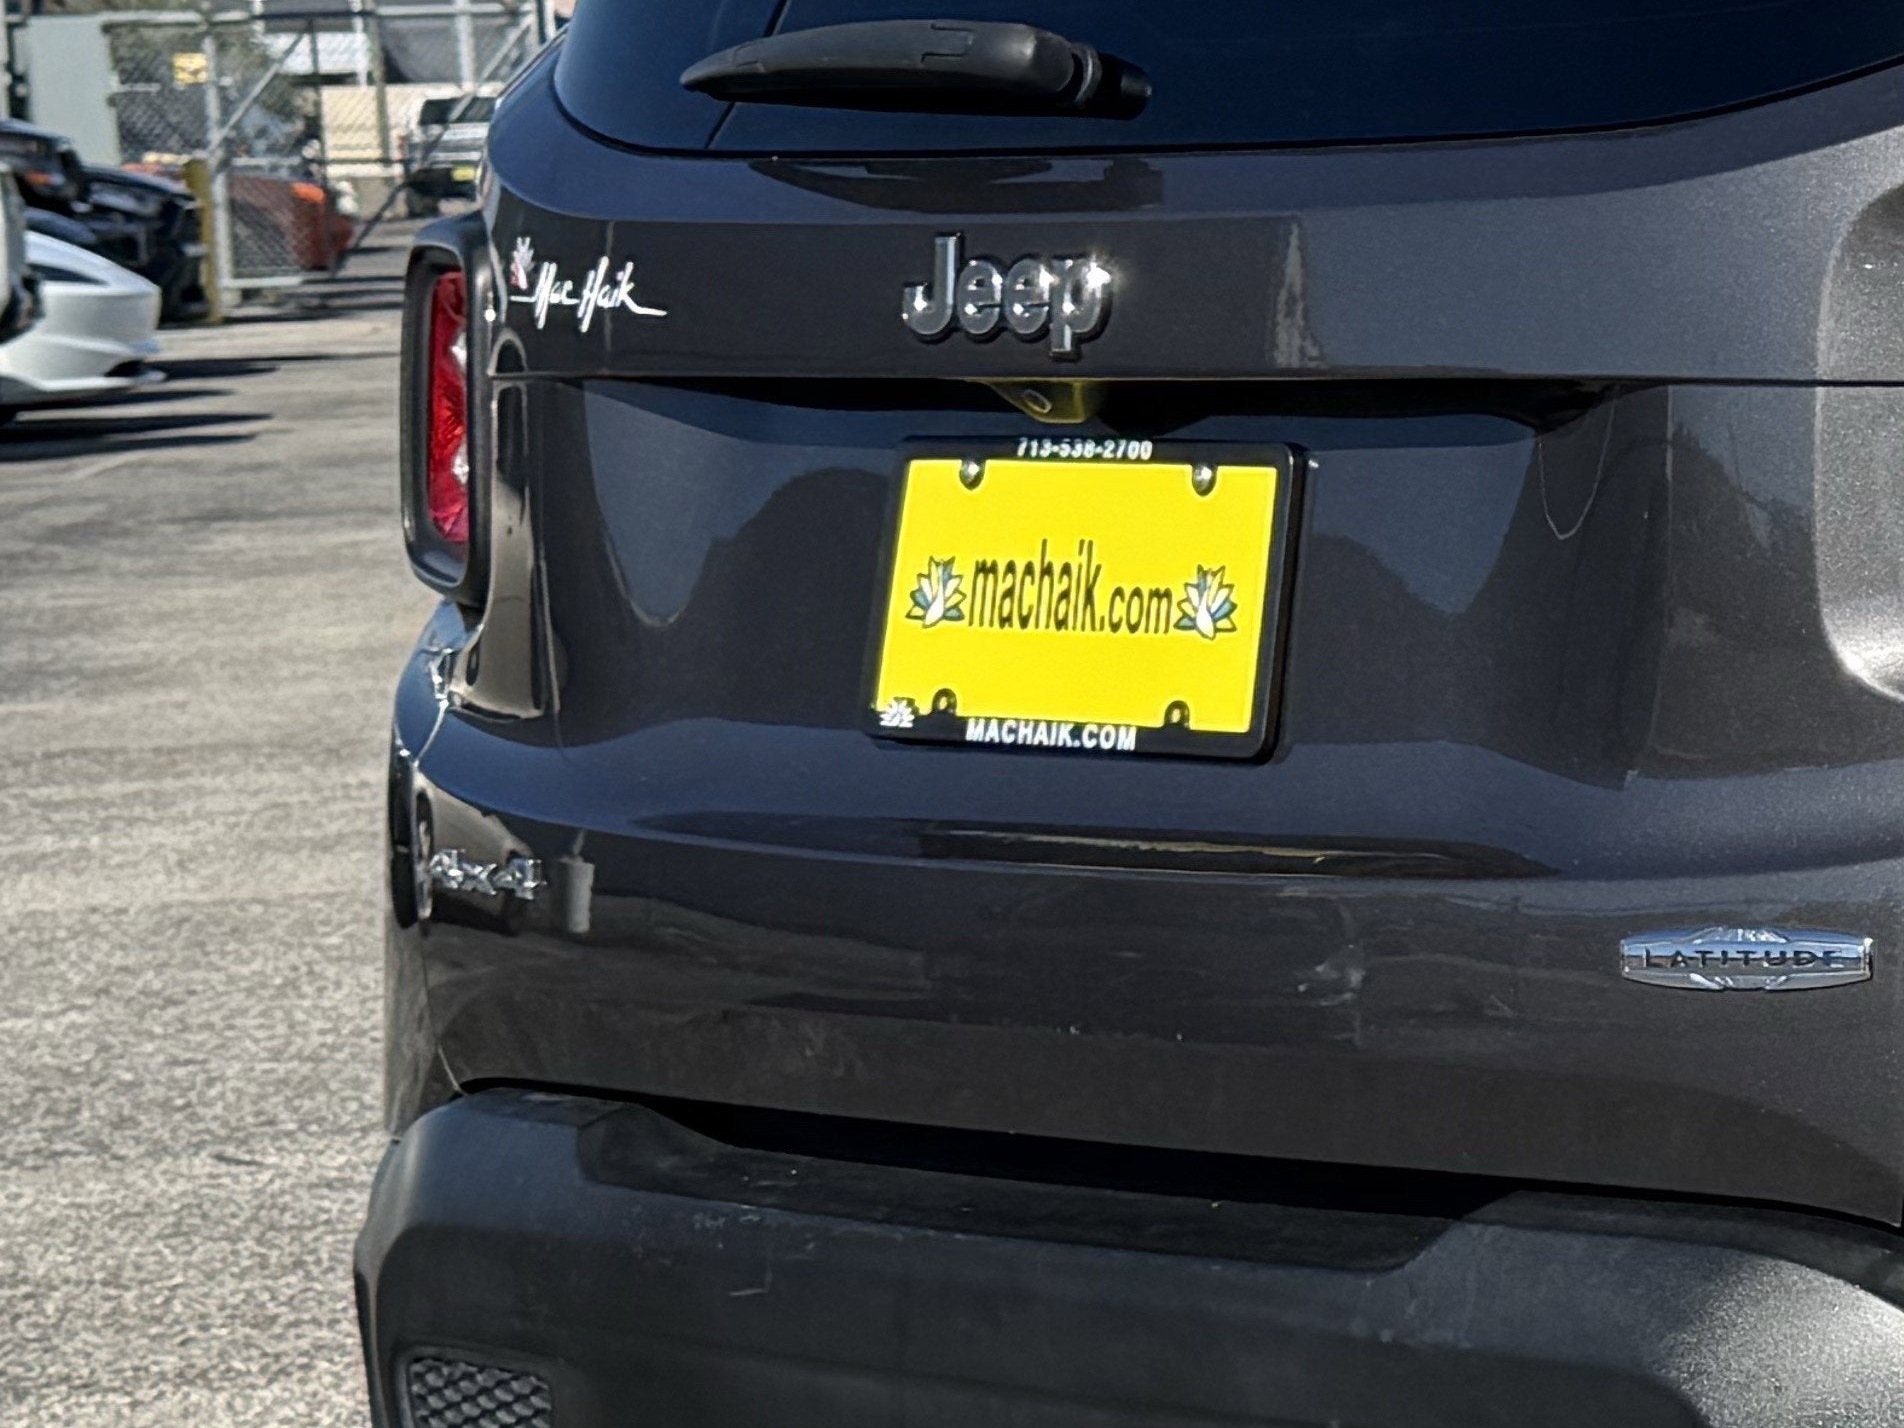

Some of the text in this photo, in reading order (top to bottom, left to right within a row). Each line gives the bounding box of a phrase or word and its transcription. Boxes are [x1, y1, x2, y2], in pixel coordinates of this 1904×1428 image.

[577, 256, 667, 332] Haik
[902, 234, 1113, 354] Jeep
[968, 538, 1172, 634] machaik.com
[965, 718, 1137, 751] MACHAIK.COM
[1642, 947, 1845, 968] LATITUDE
